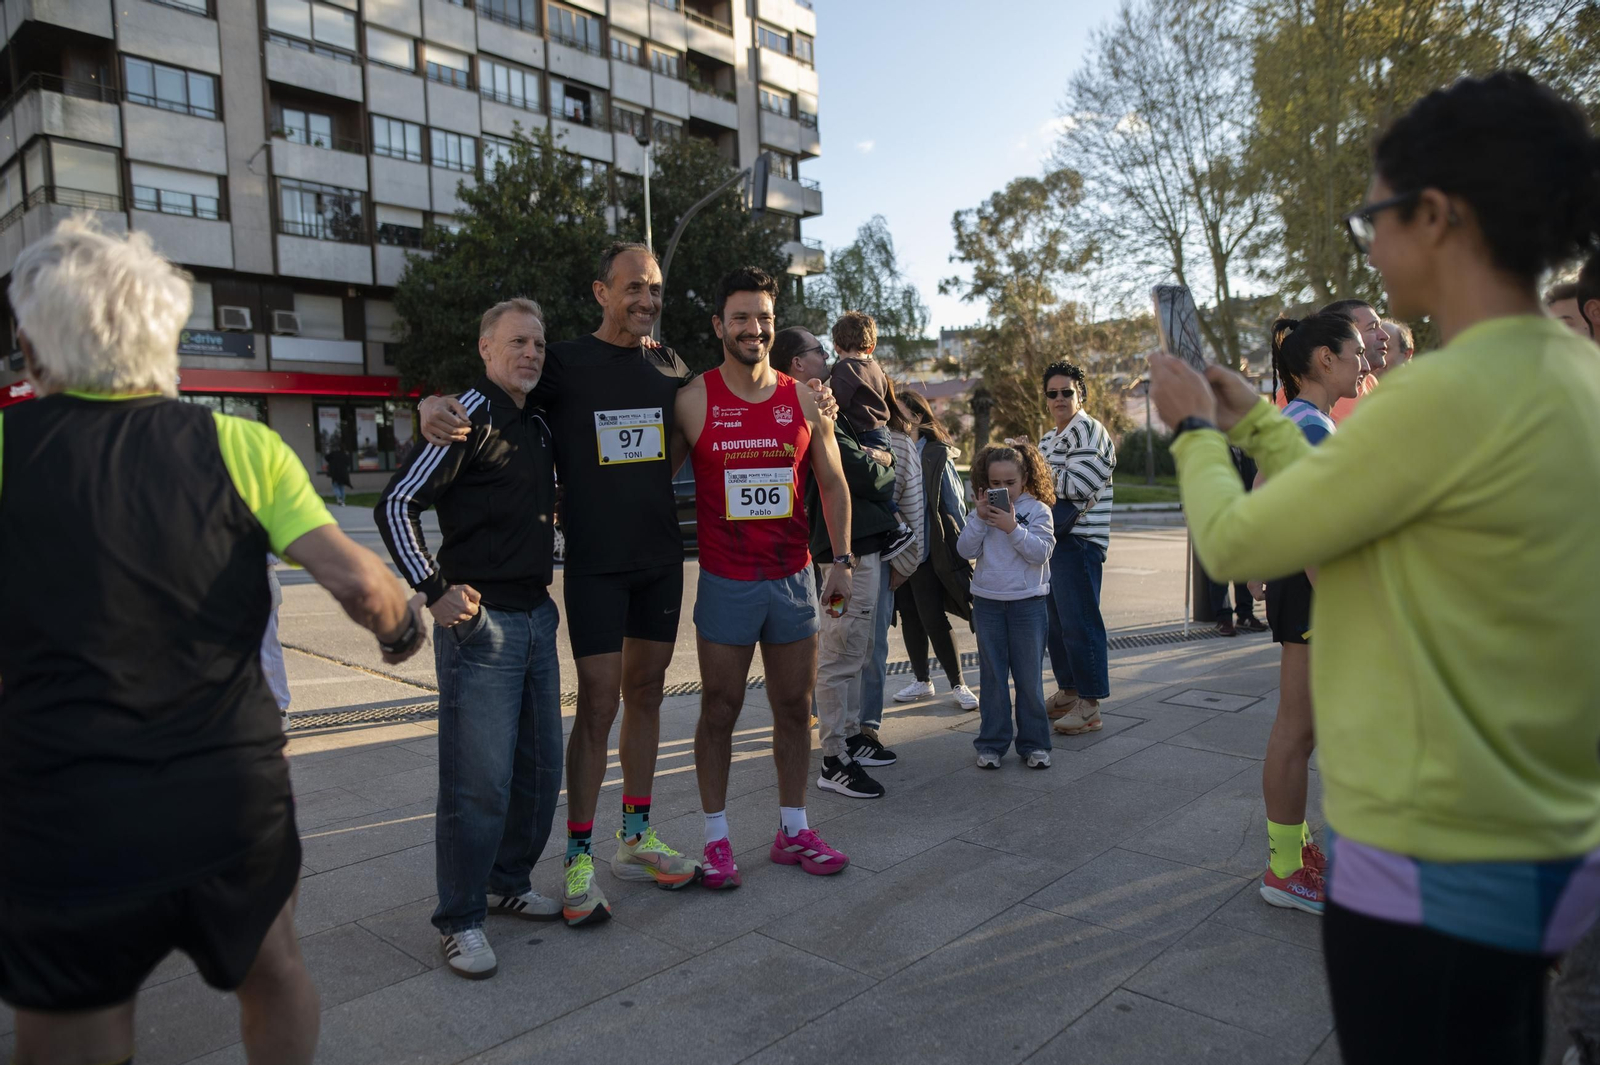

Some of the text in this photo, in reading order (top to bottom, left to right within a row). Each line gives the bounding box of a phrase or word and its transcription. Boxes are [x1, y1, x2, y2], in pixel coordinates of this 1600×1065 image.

[618, 428, 644, 448] 97
[712, 438, 778, 451] A BOUTUREIRA
[624, 451, 642, 459] TONI
[740, 486, 780, 506] 506
[1286, 881, 1317, 900] HOKA
